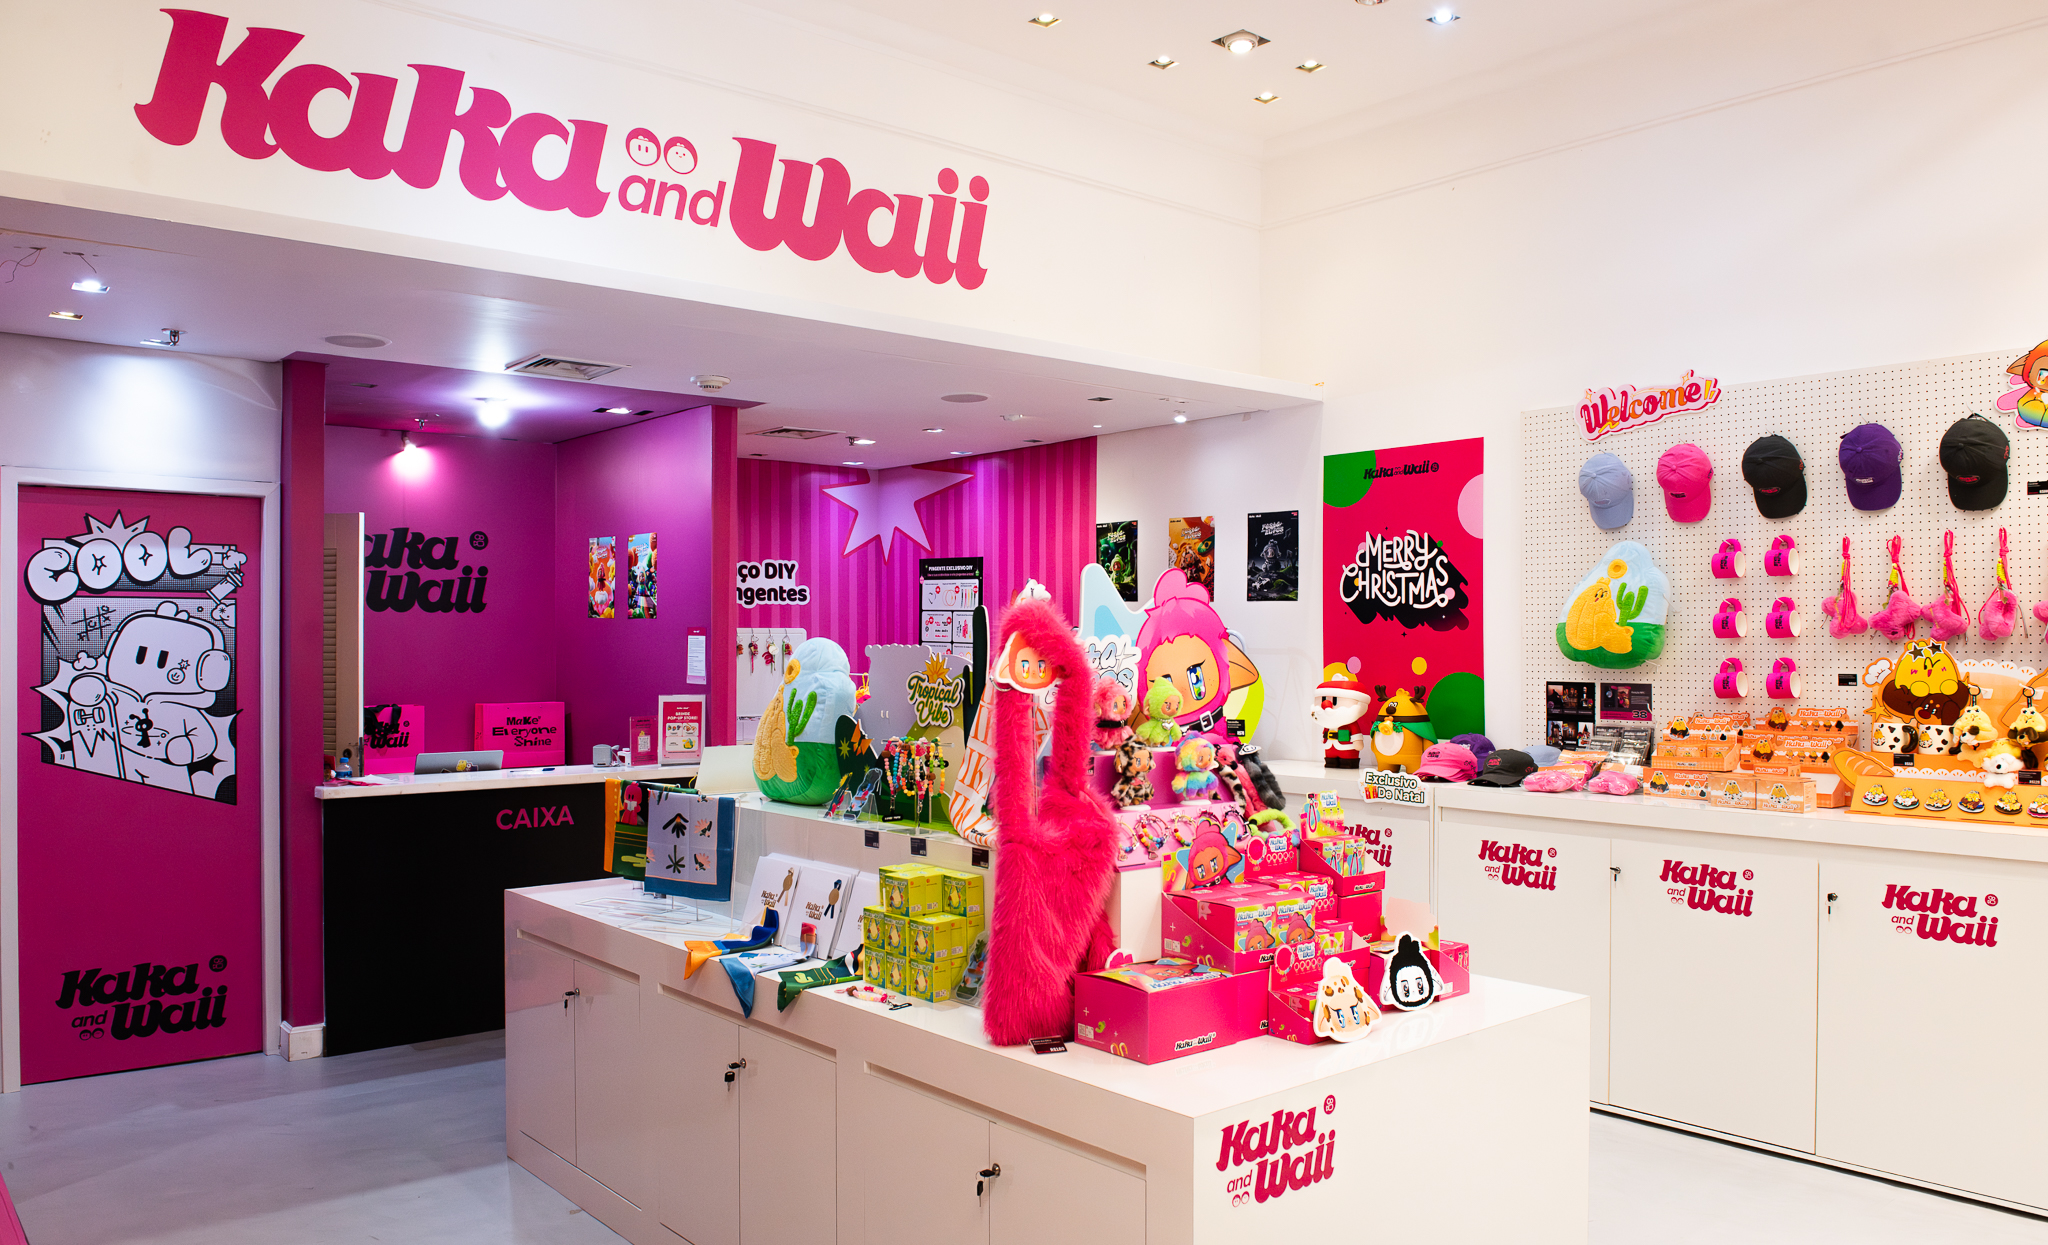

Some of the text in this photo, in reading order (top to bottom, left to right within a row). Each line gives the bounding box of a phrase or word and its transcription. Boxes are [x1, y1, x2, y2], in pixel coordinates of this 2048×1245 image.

[134, 8, 989, 290] Kaka and Waii
[1580, 379, 1715, 434] Welcome!
[1363, 467, 1394, 480] Kaka
[1403, 460, 1430, 475] Waii
[25, 526, 213, 604] COOL
[1356, 529, 1438, 572] MERRY
[764, 562, 796, 579] DIY
[1339, 555, 1449, 610] CHRISTMAS
[365, 565, 488, 614] Waii
[907, 674, 960, 707] Tropical
[916, 700, 949, 724] Vibe
[1632, 709, 1648, 719] 38
[514, 736, 552, 747] Shine
[1364, 771, 1418, 789] Exclusivo
[1377, 787, 1425, 804] De Natal
[495, 804, 575, 831] CAIXA
[1478, 839, 1544, 868] Kaka
[1484, 864, 1558, 891] and Waii
[1659, 859, 1738, 891] Kaka
[1666, 885, 1754, 917] and Waii
[1881, 883, 1979, 919] Kaka
[1891, 913, 1999, 948] and Waii
[55, 962, 200, 1010] Kaka
[71, 984, 228, 1041] and Waii
[1216, 1106, 1317, 1172] Kaka
[1227, 1129, 1336, 1204] and Waii
